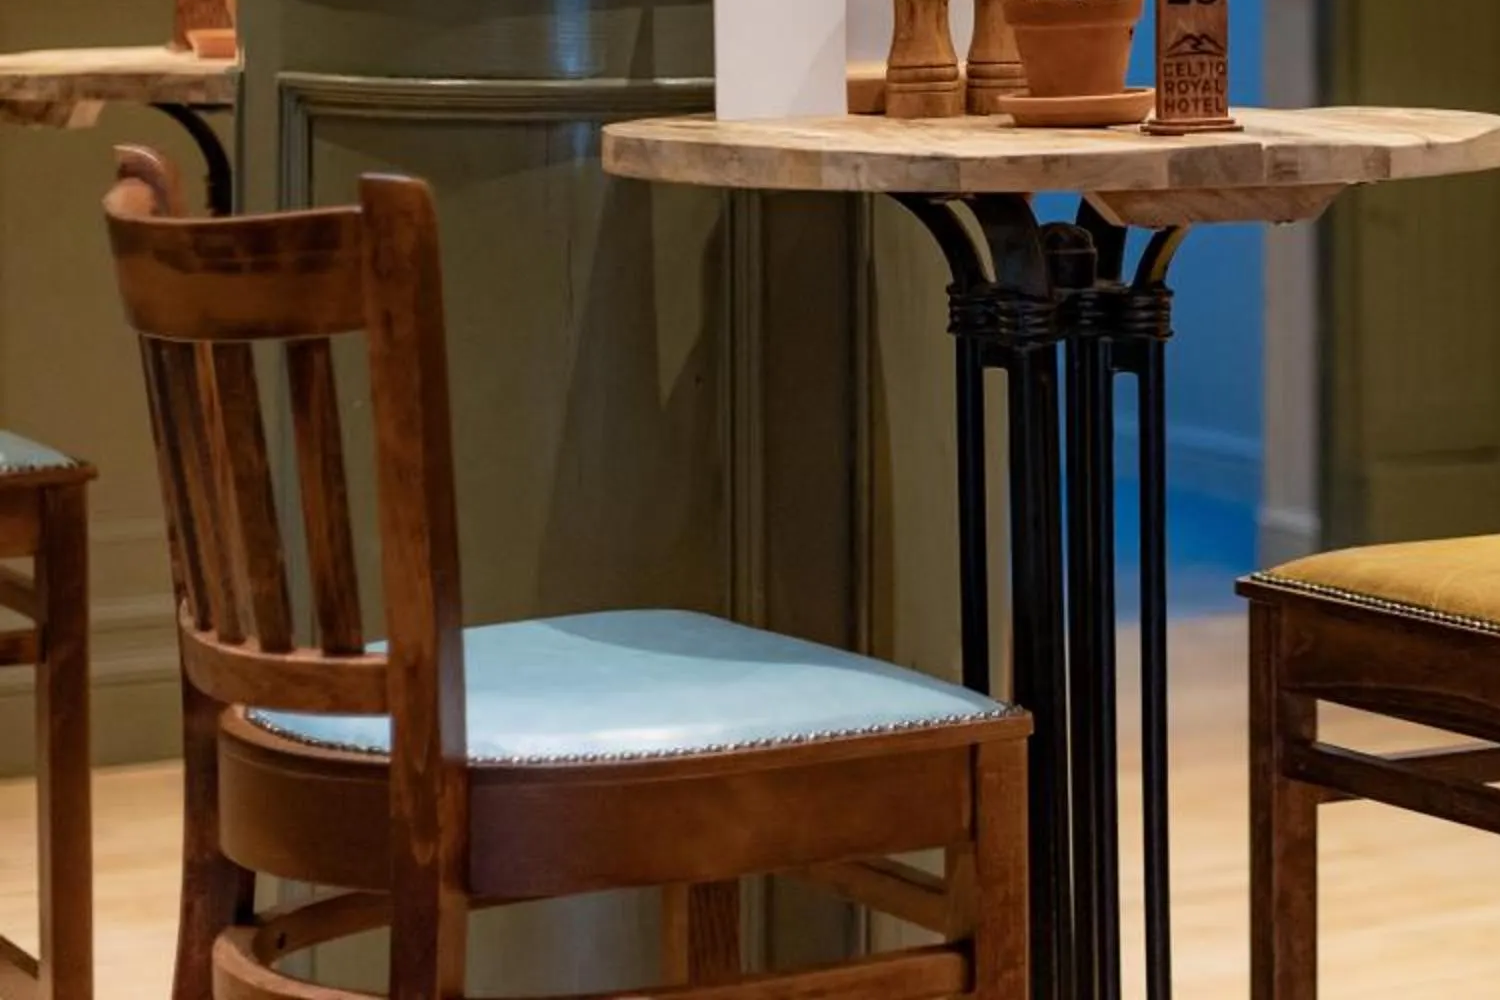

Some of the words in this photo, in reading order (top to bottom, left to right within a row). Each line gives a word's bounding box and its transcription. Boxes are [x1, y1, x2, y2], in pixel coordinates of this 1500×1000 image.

[1163, 61, 1226, 78] CELTIC
[1164, 79, 1225, 97] ROYAL
[1165, 98, 1225, 114] HOTEL
